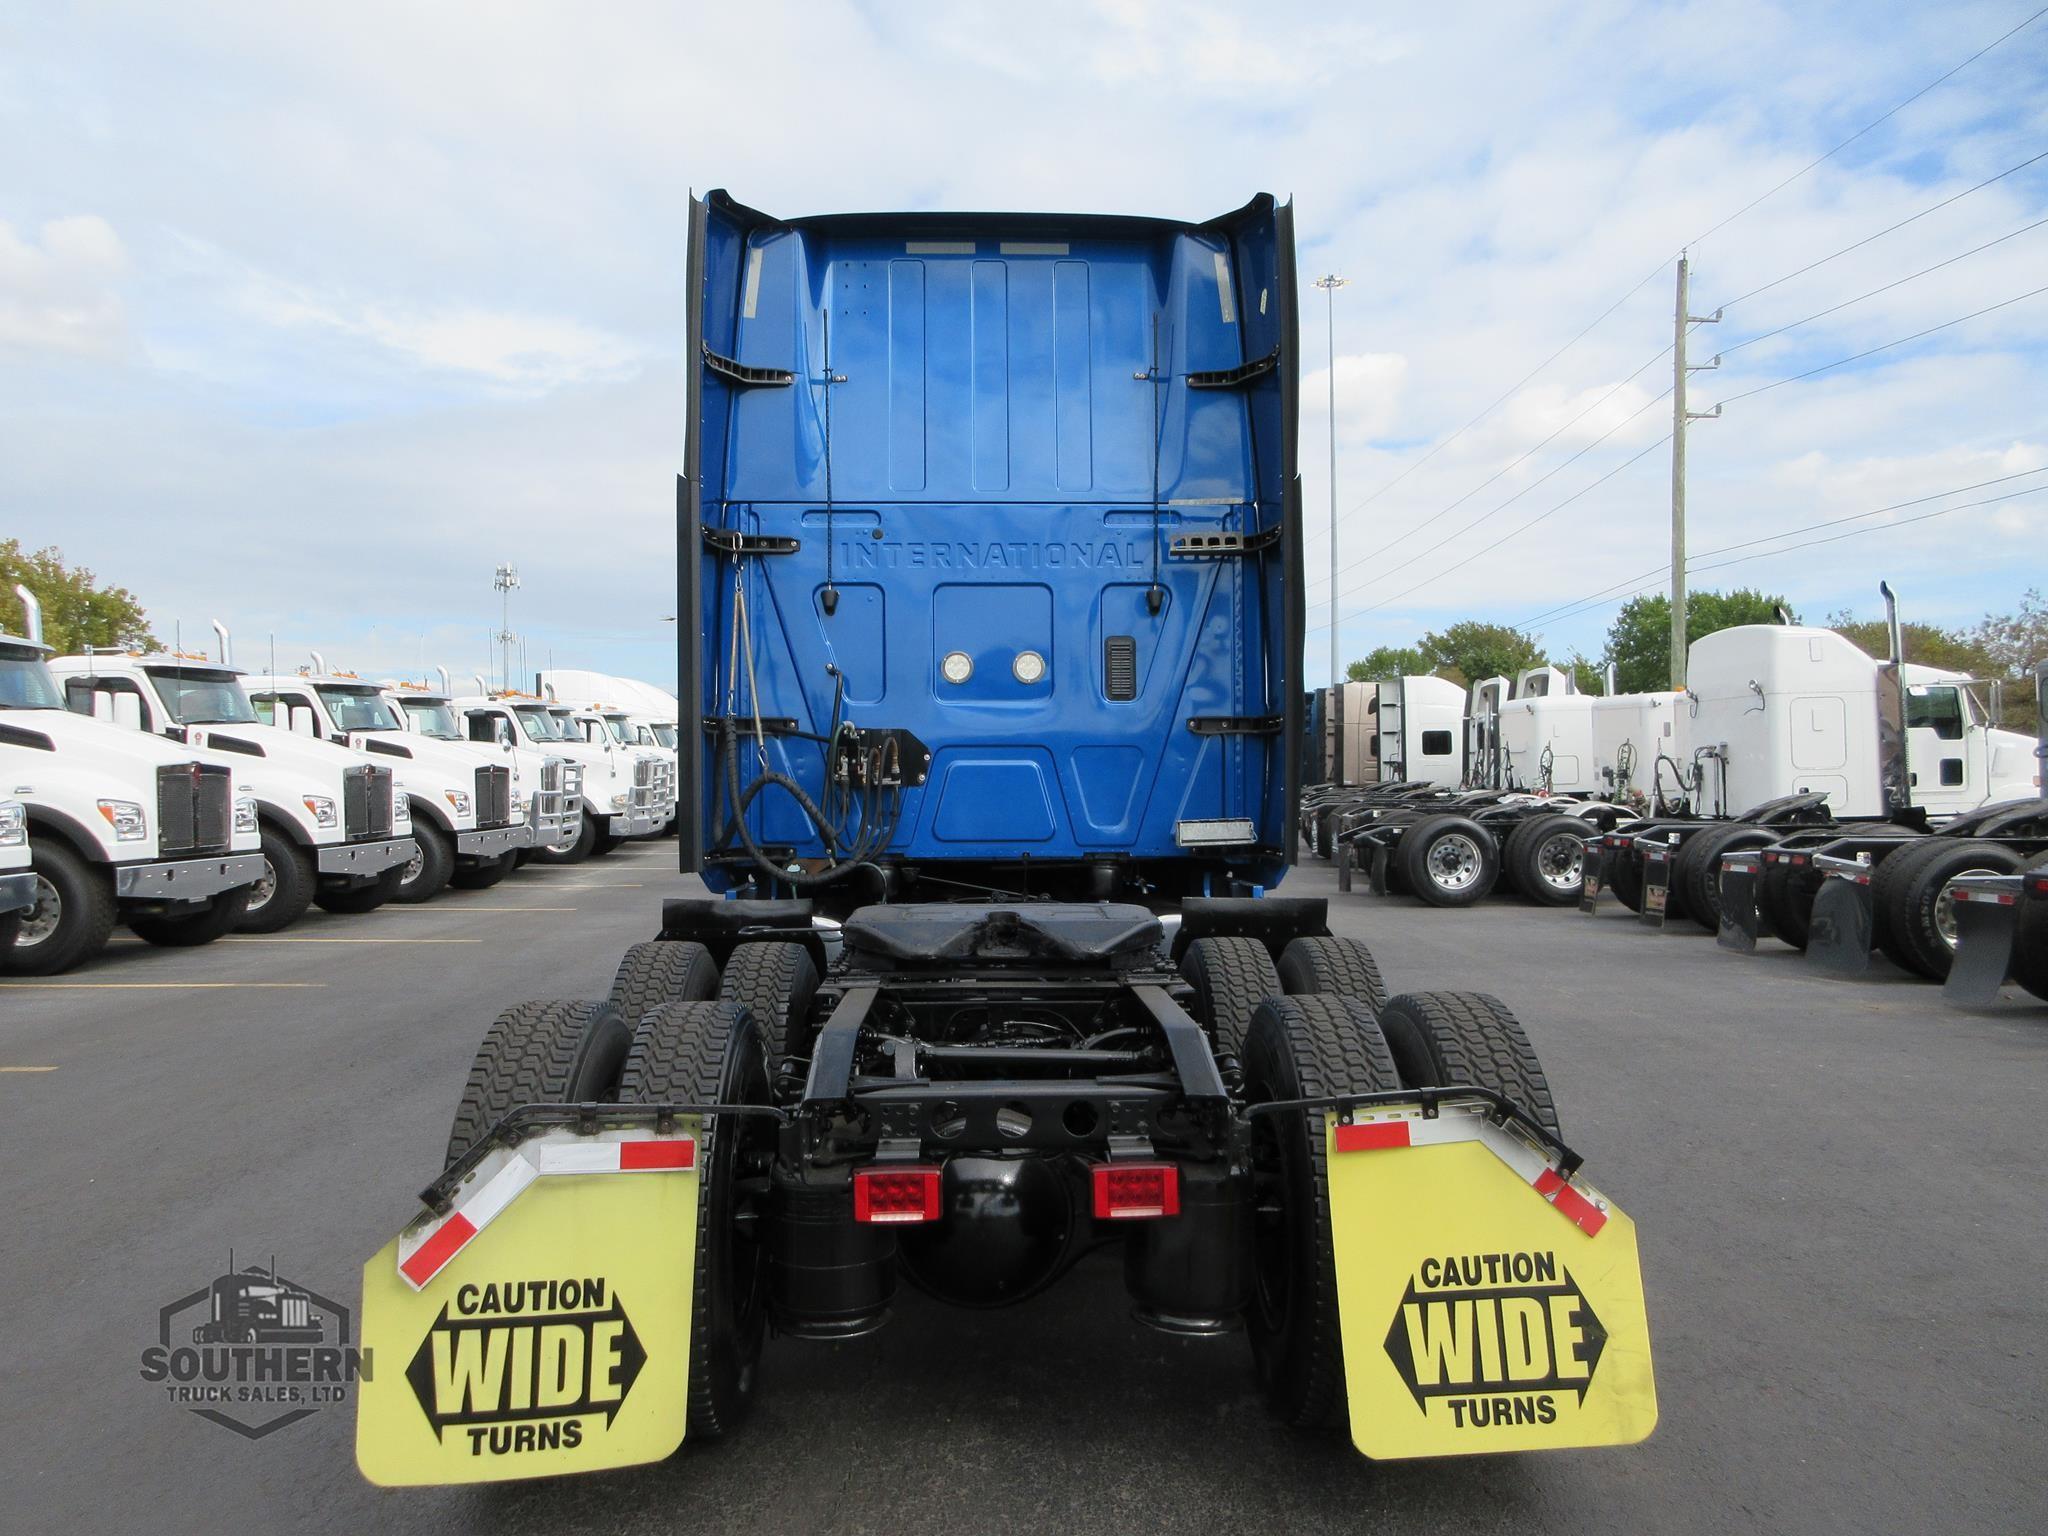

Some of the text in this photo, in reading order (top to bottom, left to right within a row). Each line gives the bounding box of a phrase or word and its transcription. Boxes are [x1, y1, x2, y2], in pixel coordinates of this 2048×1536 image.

[840, 542, 1144, 569] INTERNATIONAL
[1420, 1251, 1556, 1288] CAUTION
[456, 1277, 605, 1315] CAUTION
[1402, 1295, 1590, 1386] WIDE
[431, 1319, 624, 1415] WIDE
[1447, 1395, 1557, 1428] TURNS
[467, 1419, 583, 1456] TURNS
